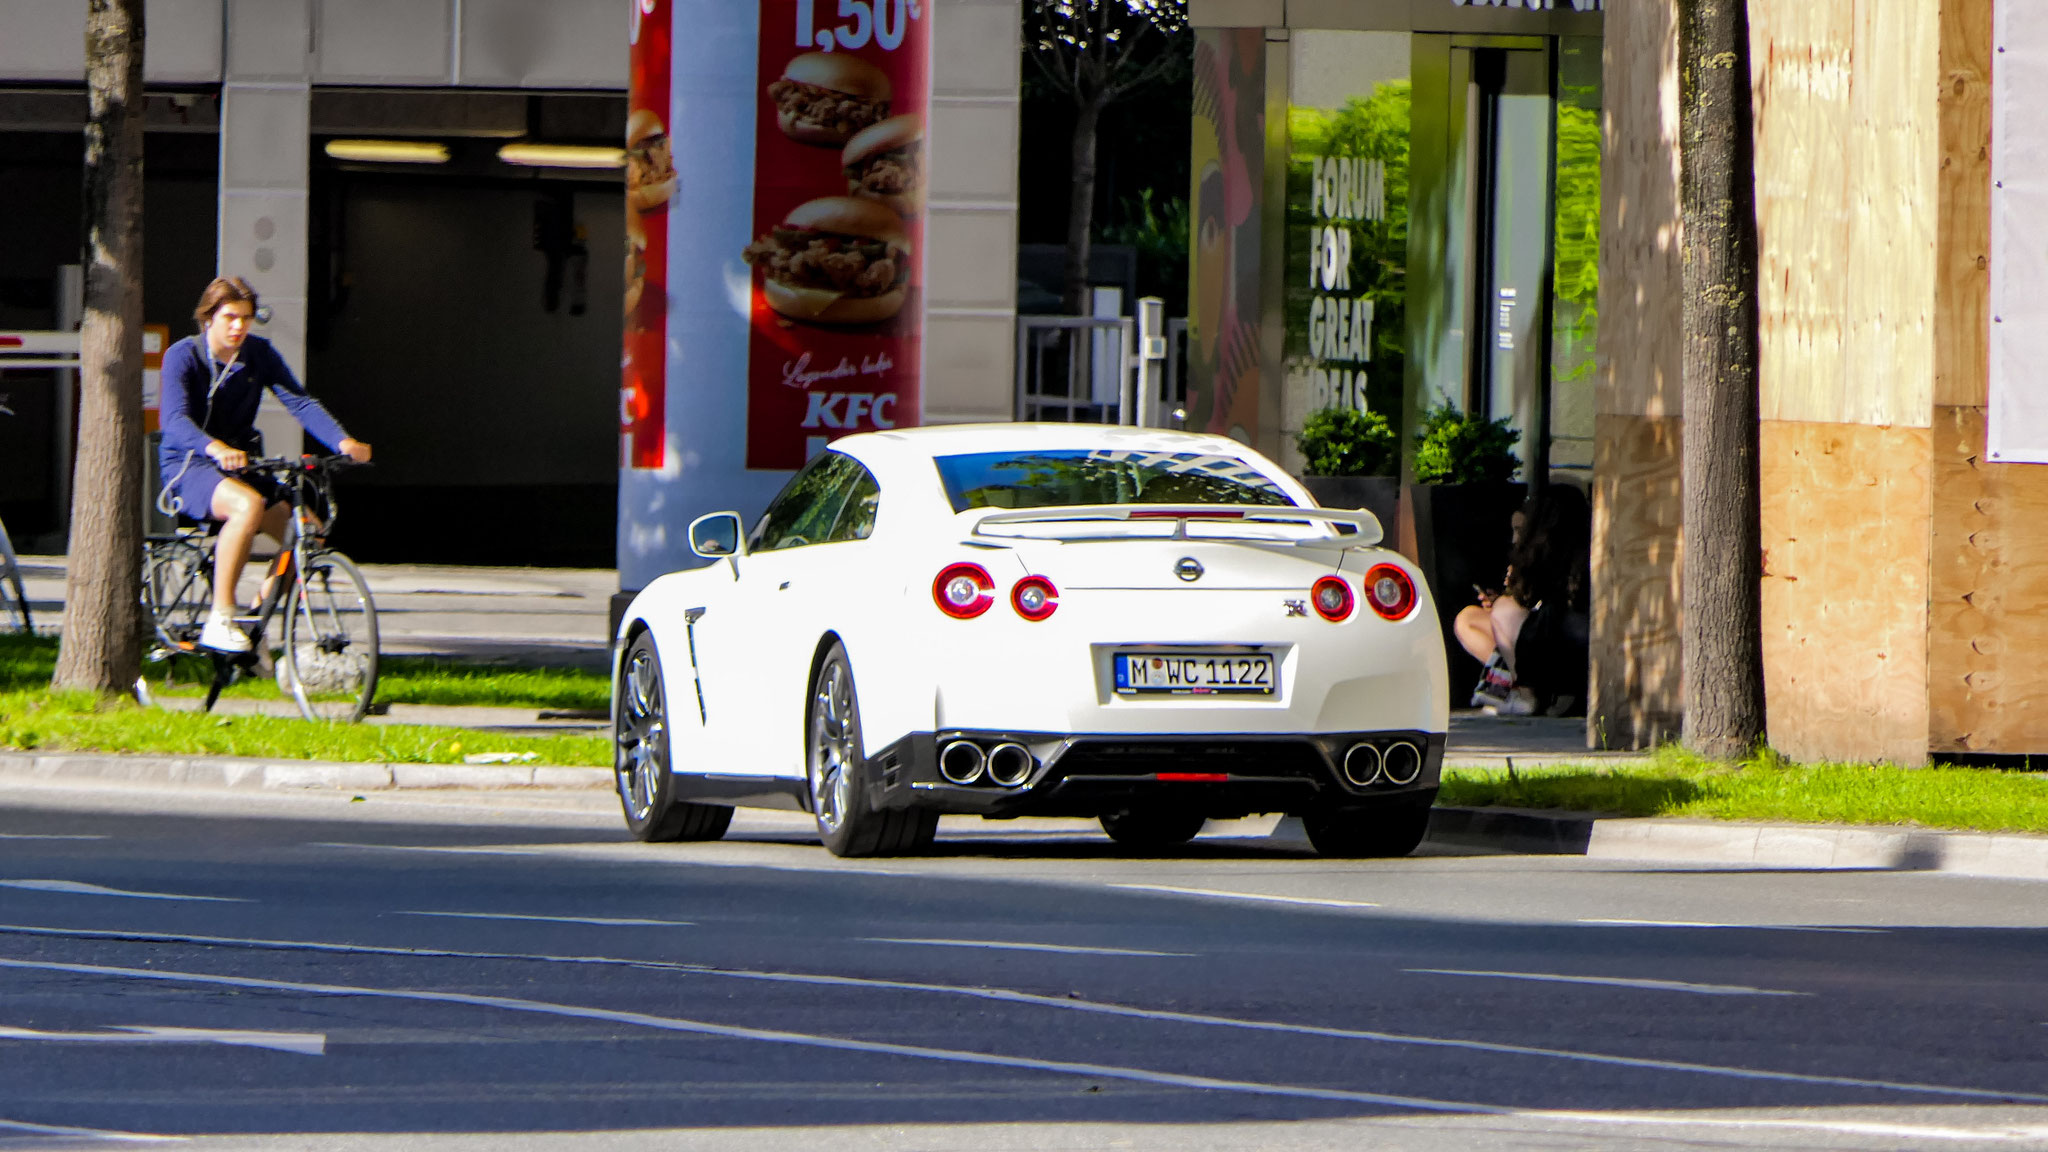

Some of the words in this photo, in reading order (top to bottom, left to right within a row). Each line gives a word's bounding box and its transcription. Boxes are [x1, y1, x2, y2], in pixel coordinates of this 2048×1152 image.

[1311, 155, 1385, 221] FORUM
[1309, 225, 1351, 292] FOR
[1309, 296, 1374, 362] GREAT
[800, 392, 898, 430] KFC
[1131, 658, 1148, 685] M
[1165, 658, 1199, 685] WC
[1205, 658, 1269, 685] 1122
